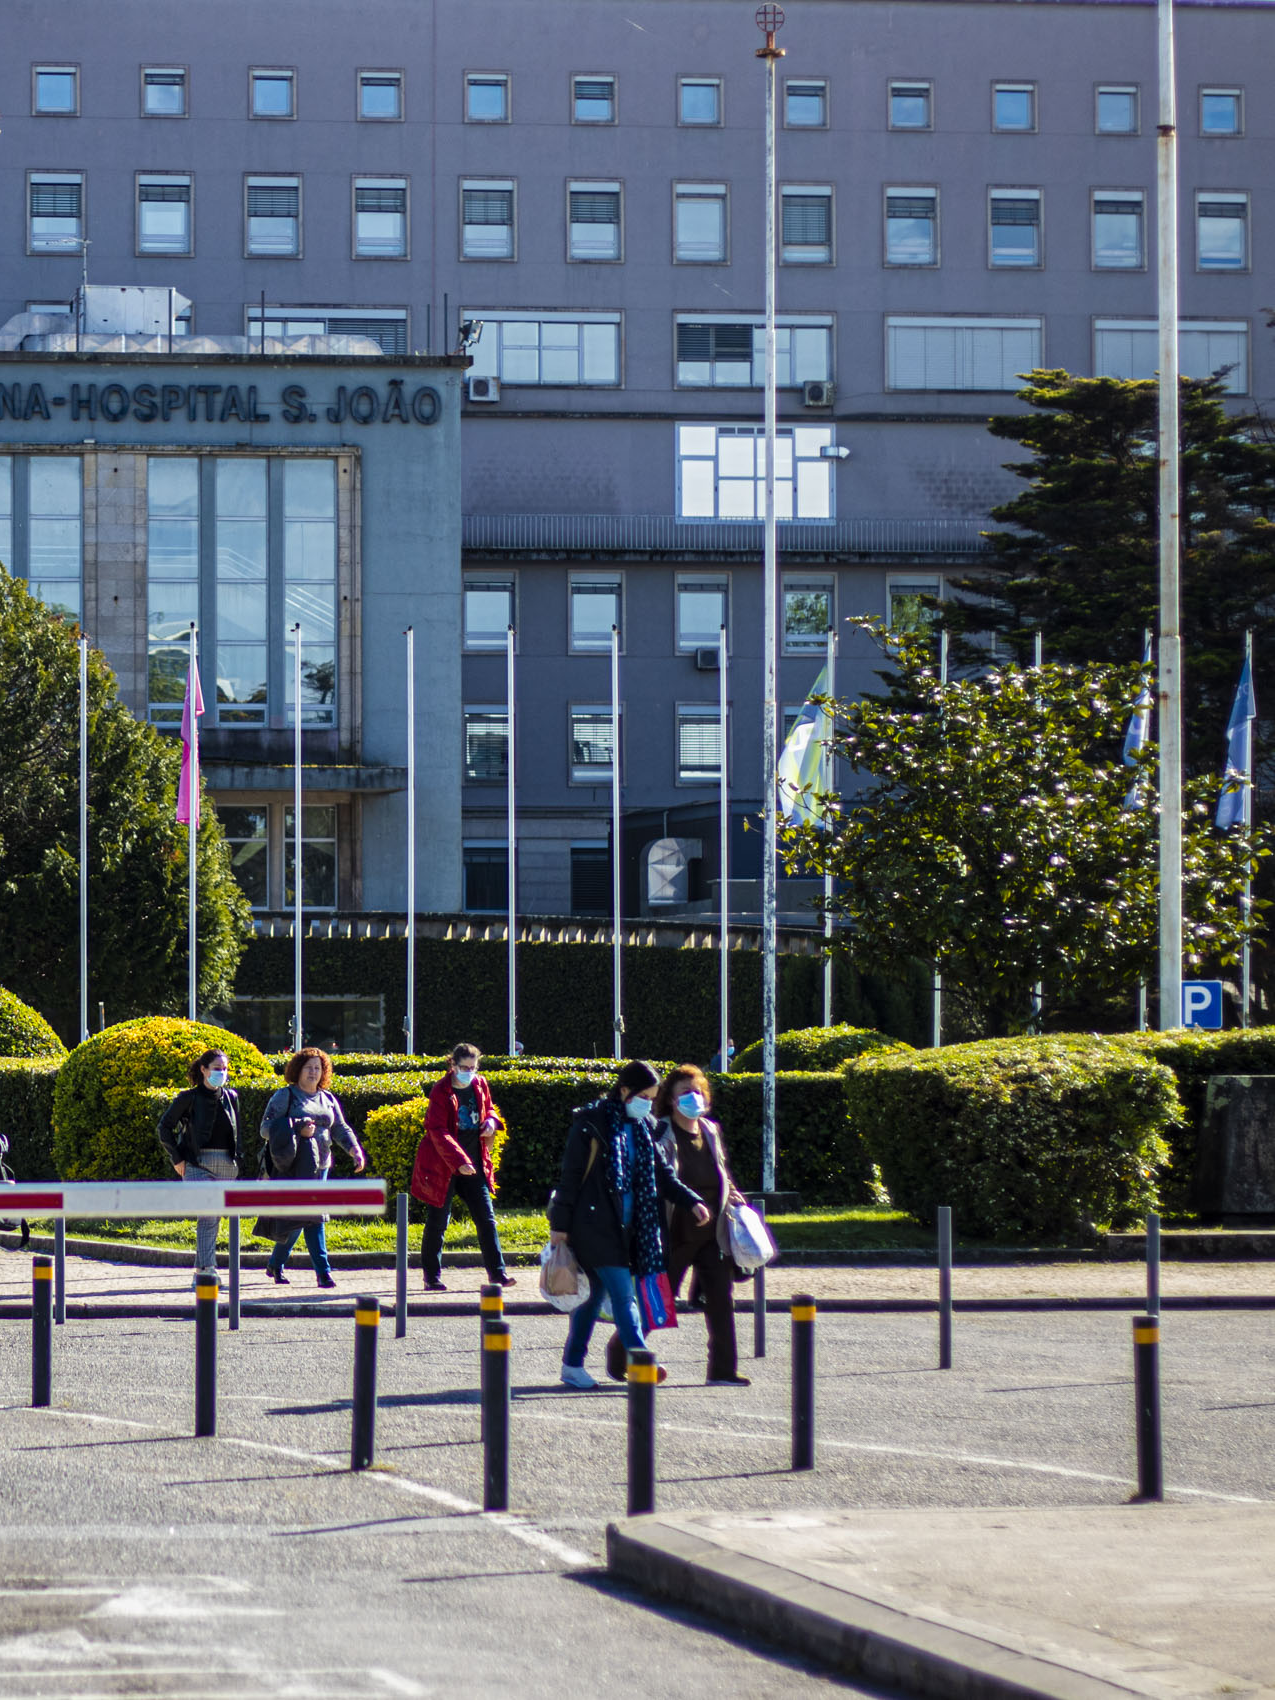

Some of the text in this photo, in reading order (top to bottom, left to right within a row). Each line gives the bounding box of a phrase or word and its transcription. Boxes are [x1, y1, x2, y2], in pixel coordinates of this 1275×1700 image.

[282, 385, 317, 424] S.
[327, 378, 442, 425] JOÃO
[1185, 986, 1212, 1024] P
